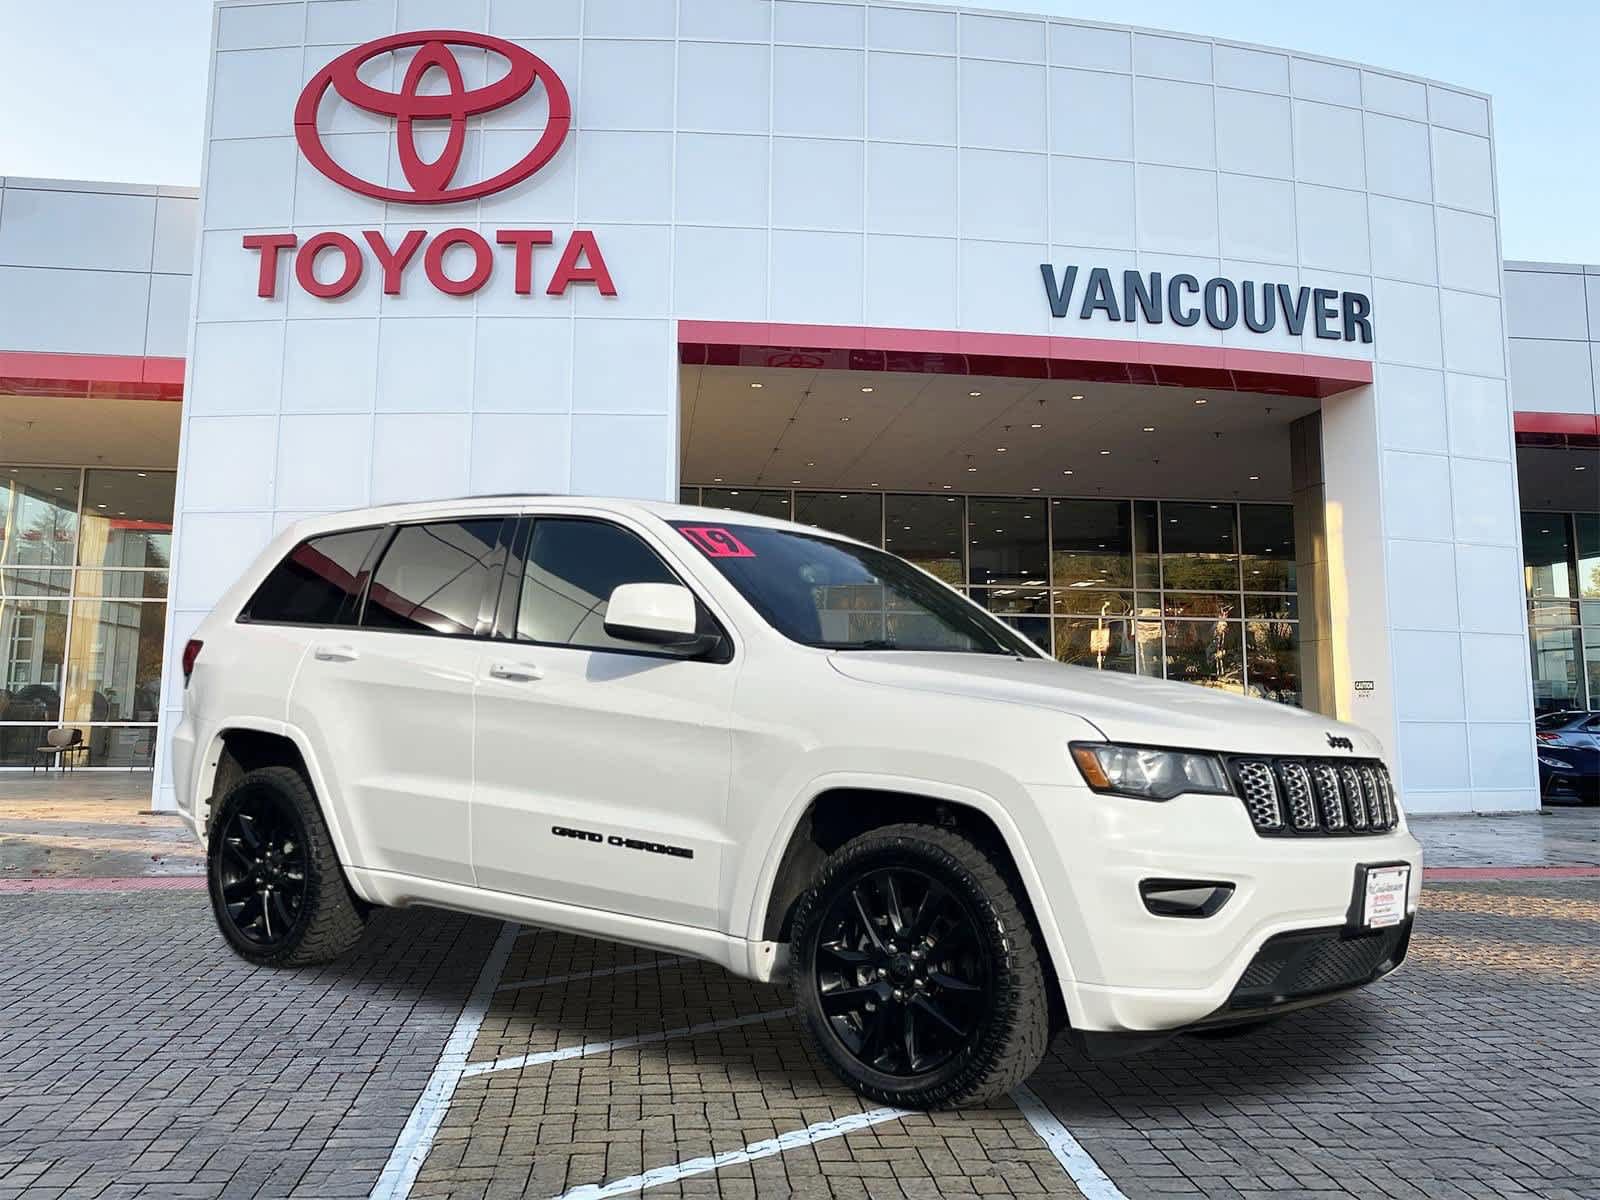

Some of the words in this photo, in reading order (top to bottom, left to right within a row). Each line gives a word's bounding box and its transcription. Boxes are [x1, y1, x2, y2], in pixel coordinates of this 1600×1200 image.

[242, 228, 617, 299] TOYOTA
[1040, 263, 1374, 345] VANCOUVER
[685, 529, 740, 554] 19
[551, 826, 604, 843] GRAND
[607, 835, 695, 860] CHEROKEE
